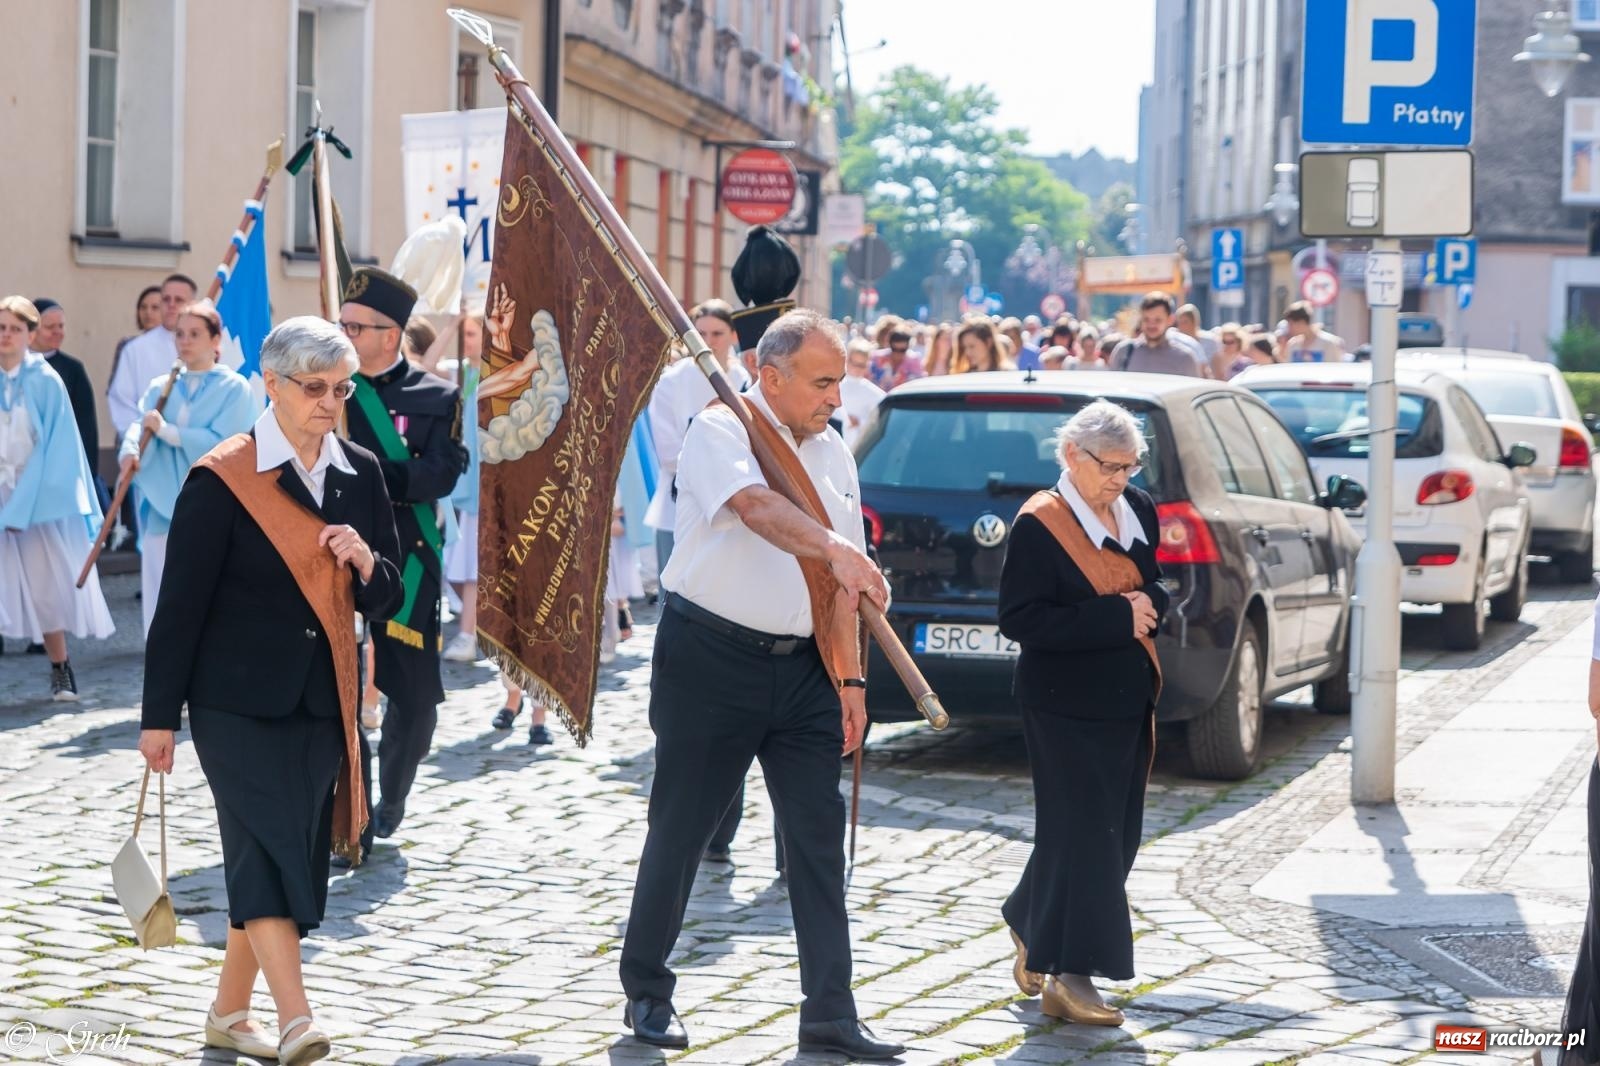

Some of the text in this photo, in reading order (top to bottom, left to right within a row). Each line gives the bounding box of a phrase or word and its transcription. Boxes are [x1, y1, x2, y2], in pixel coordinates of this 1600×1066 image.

[1342, 0, 1439, 124] P
[1393, 103, 1465, 131] Płatny
[1218, 261, 1239, 287] P
[1444, 242, 1470, 280] P
[584, 307, 609, 357] PANNY
[506, 476, 560, 567] ZAKON
[931, 627, 982, 651] SRC
